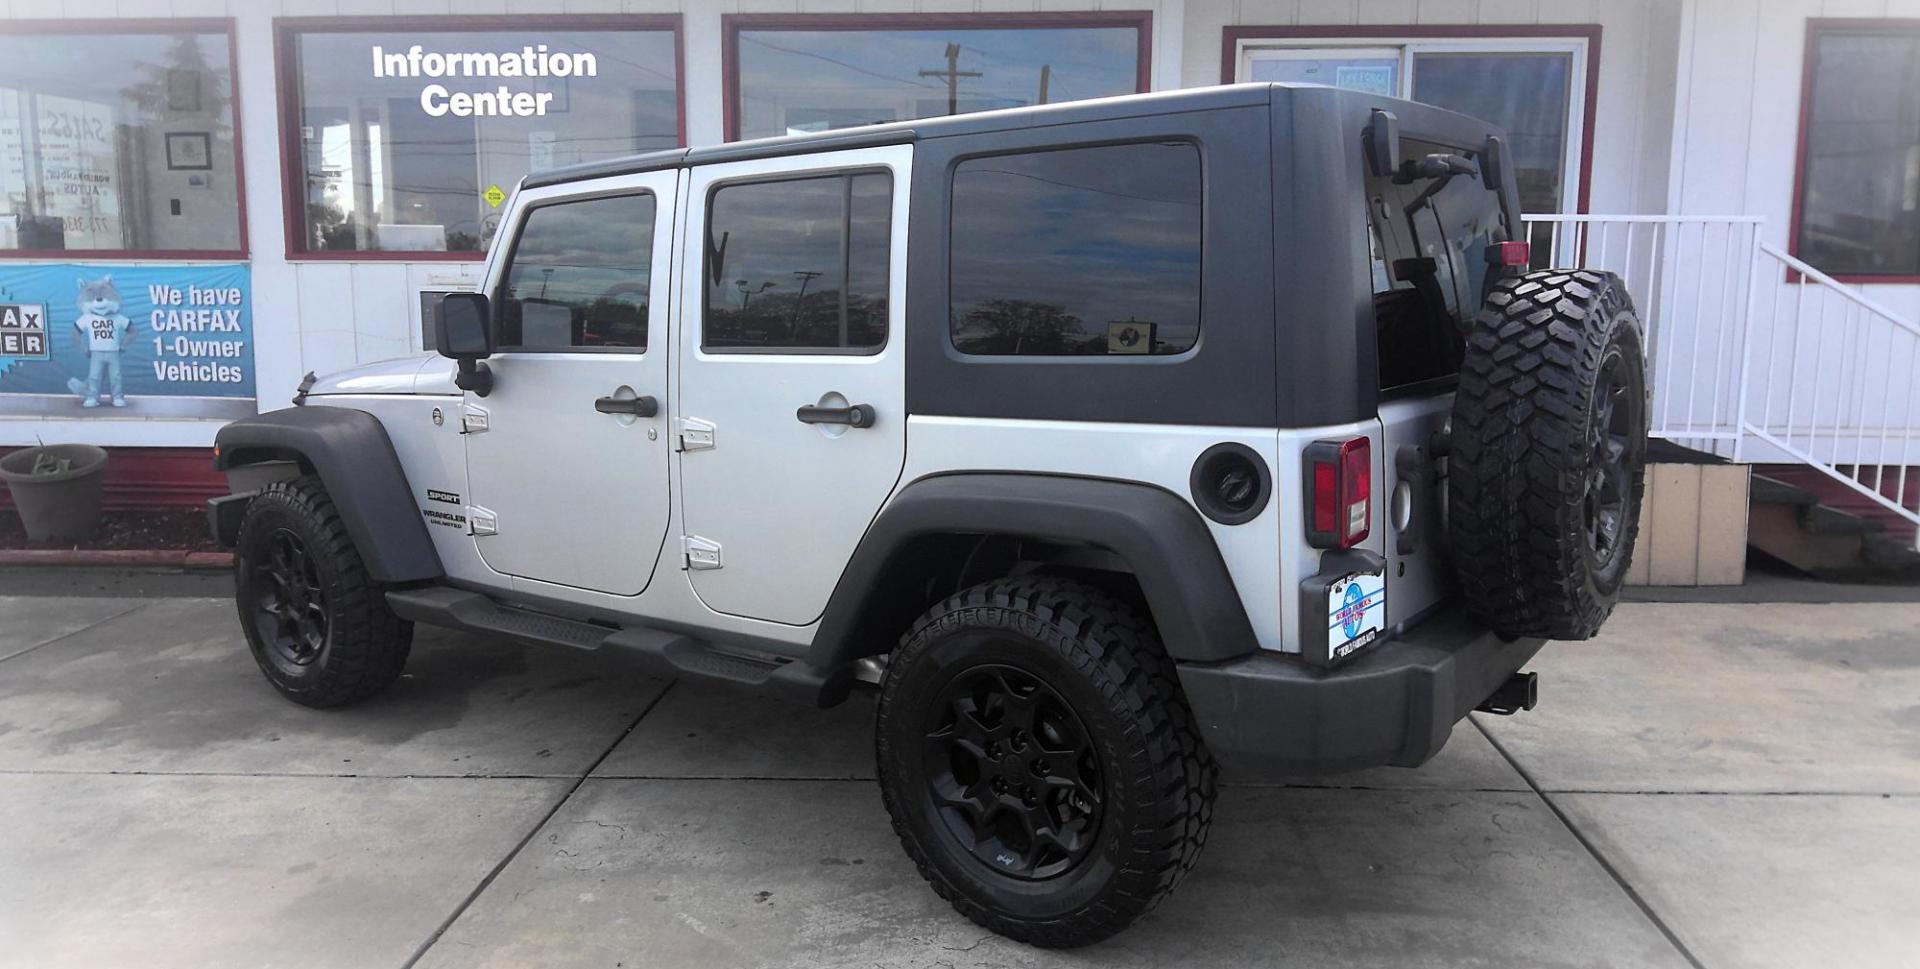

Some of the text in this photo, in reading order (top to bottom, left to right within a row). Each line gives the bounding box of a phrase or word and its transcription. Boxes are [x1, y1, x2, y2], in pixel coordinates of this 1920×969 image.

[372, 45, 597, 78] Information
[420, 84, 553, 117] Center
[149, 284, 241, 306] We have
[91, 320, 114, 330] CAR
[151, 309, 242, 332] CARFAX
[94, 330, 114, 340] FOX
[153, 336, 243, 358] 1-Owner
[154, 360, 243, 383] Vehicles
[429, 491, 458, 502] SPORT
[423, 509, 466, 524] WRANGLER
[431, 519, 462, 528] UNLIMITED
